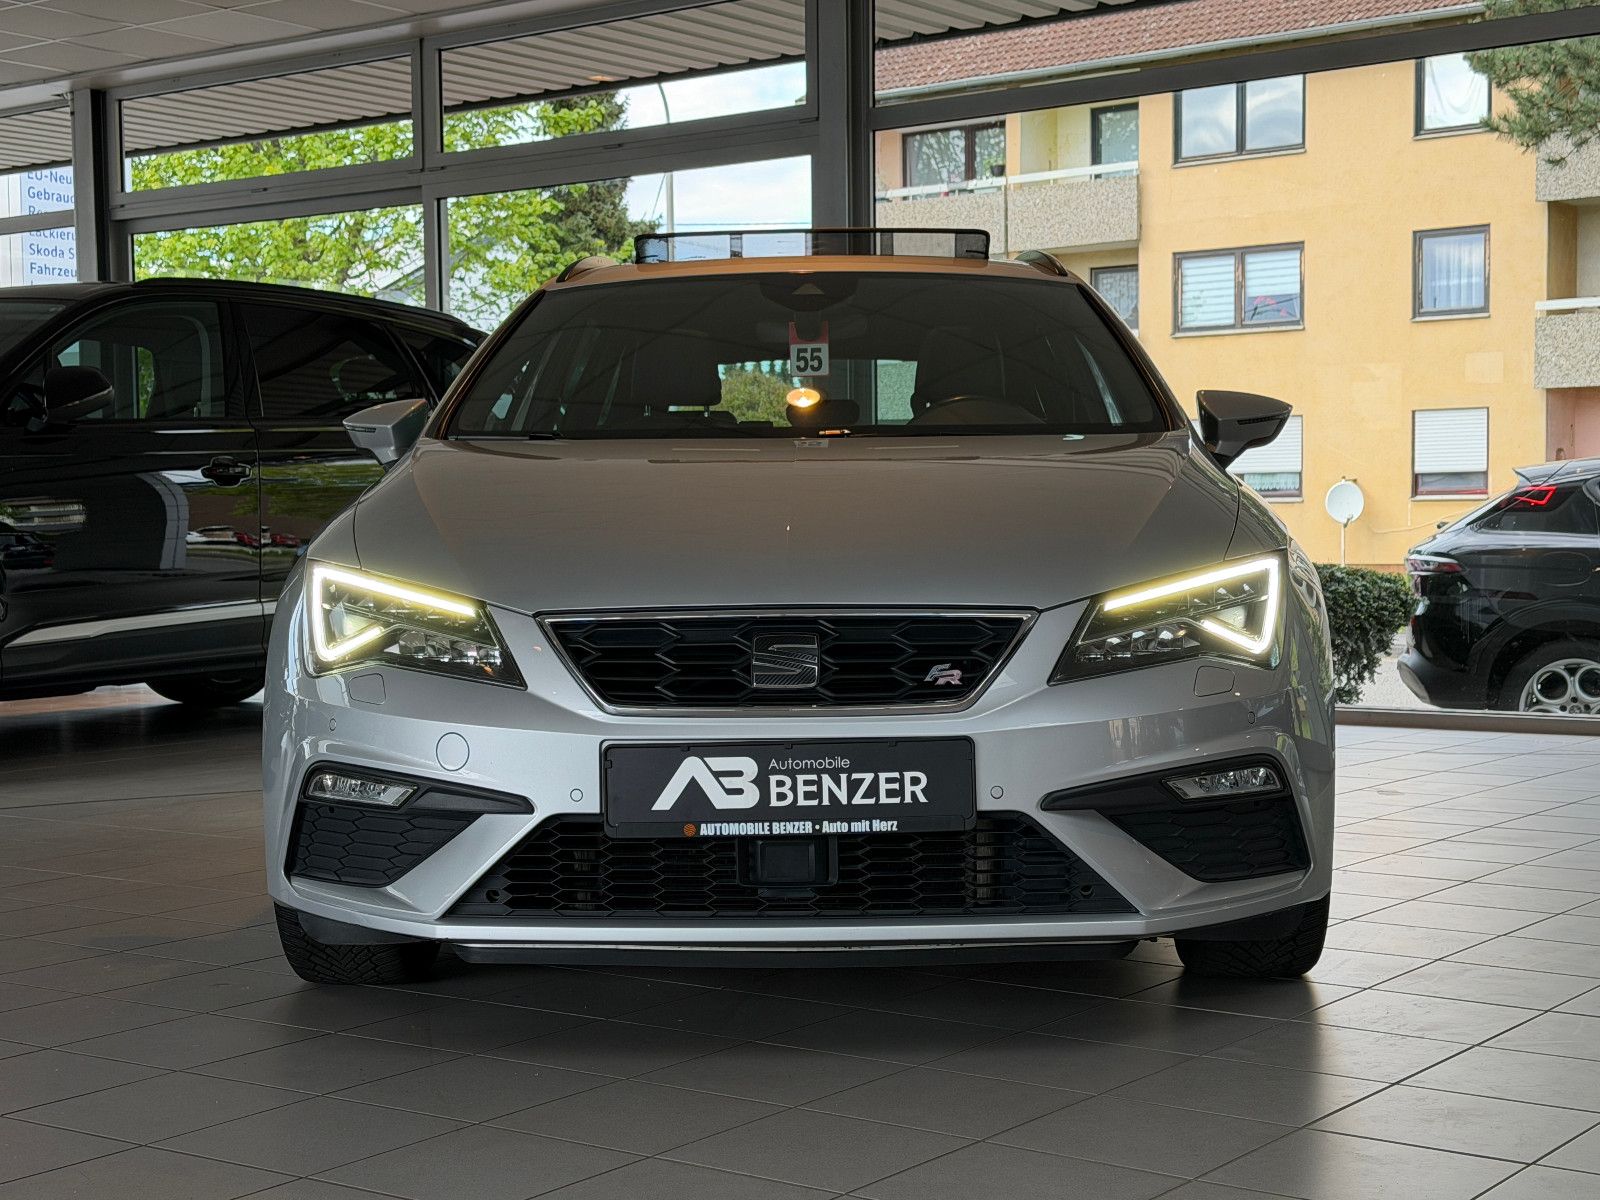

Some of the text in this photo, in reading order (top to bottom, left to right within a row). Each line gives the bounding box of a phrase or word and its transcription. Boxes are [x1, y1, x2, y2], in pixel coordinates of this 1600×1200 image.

[29, 243, 65, 258] Skoda
[796, 347, 823, 373] 55
[924, 663, 962, 686] FR
[768, 757, 851, 770] Automobile
[768, 771, 929, 807] BENZER
[700, 819, 898, 836] AUTOMOBILE BENZER Auto mit Herz
